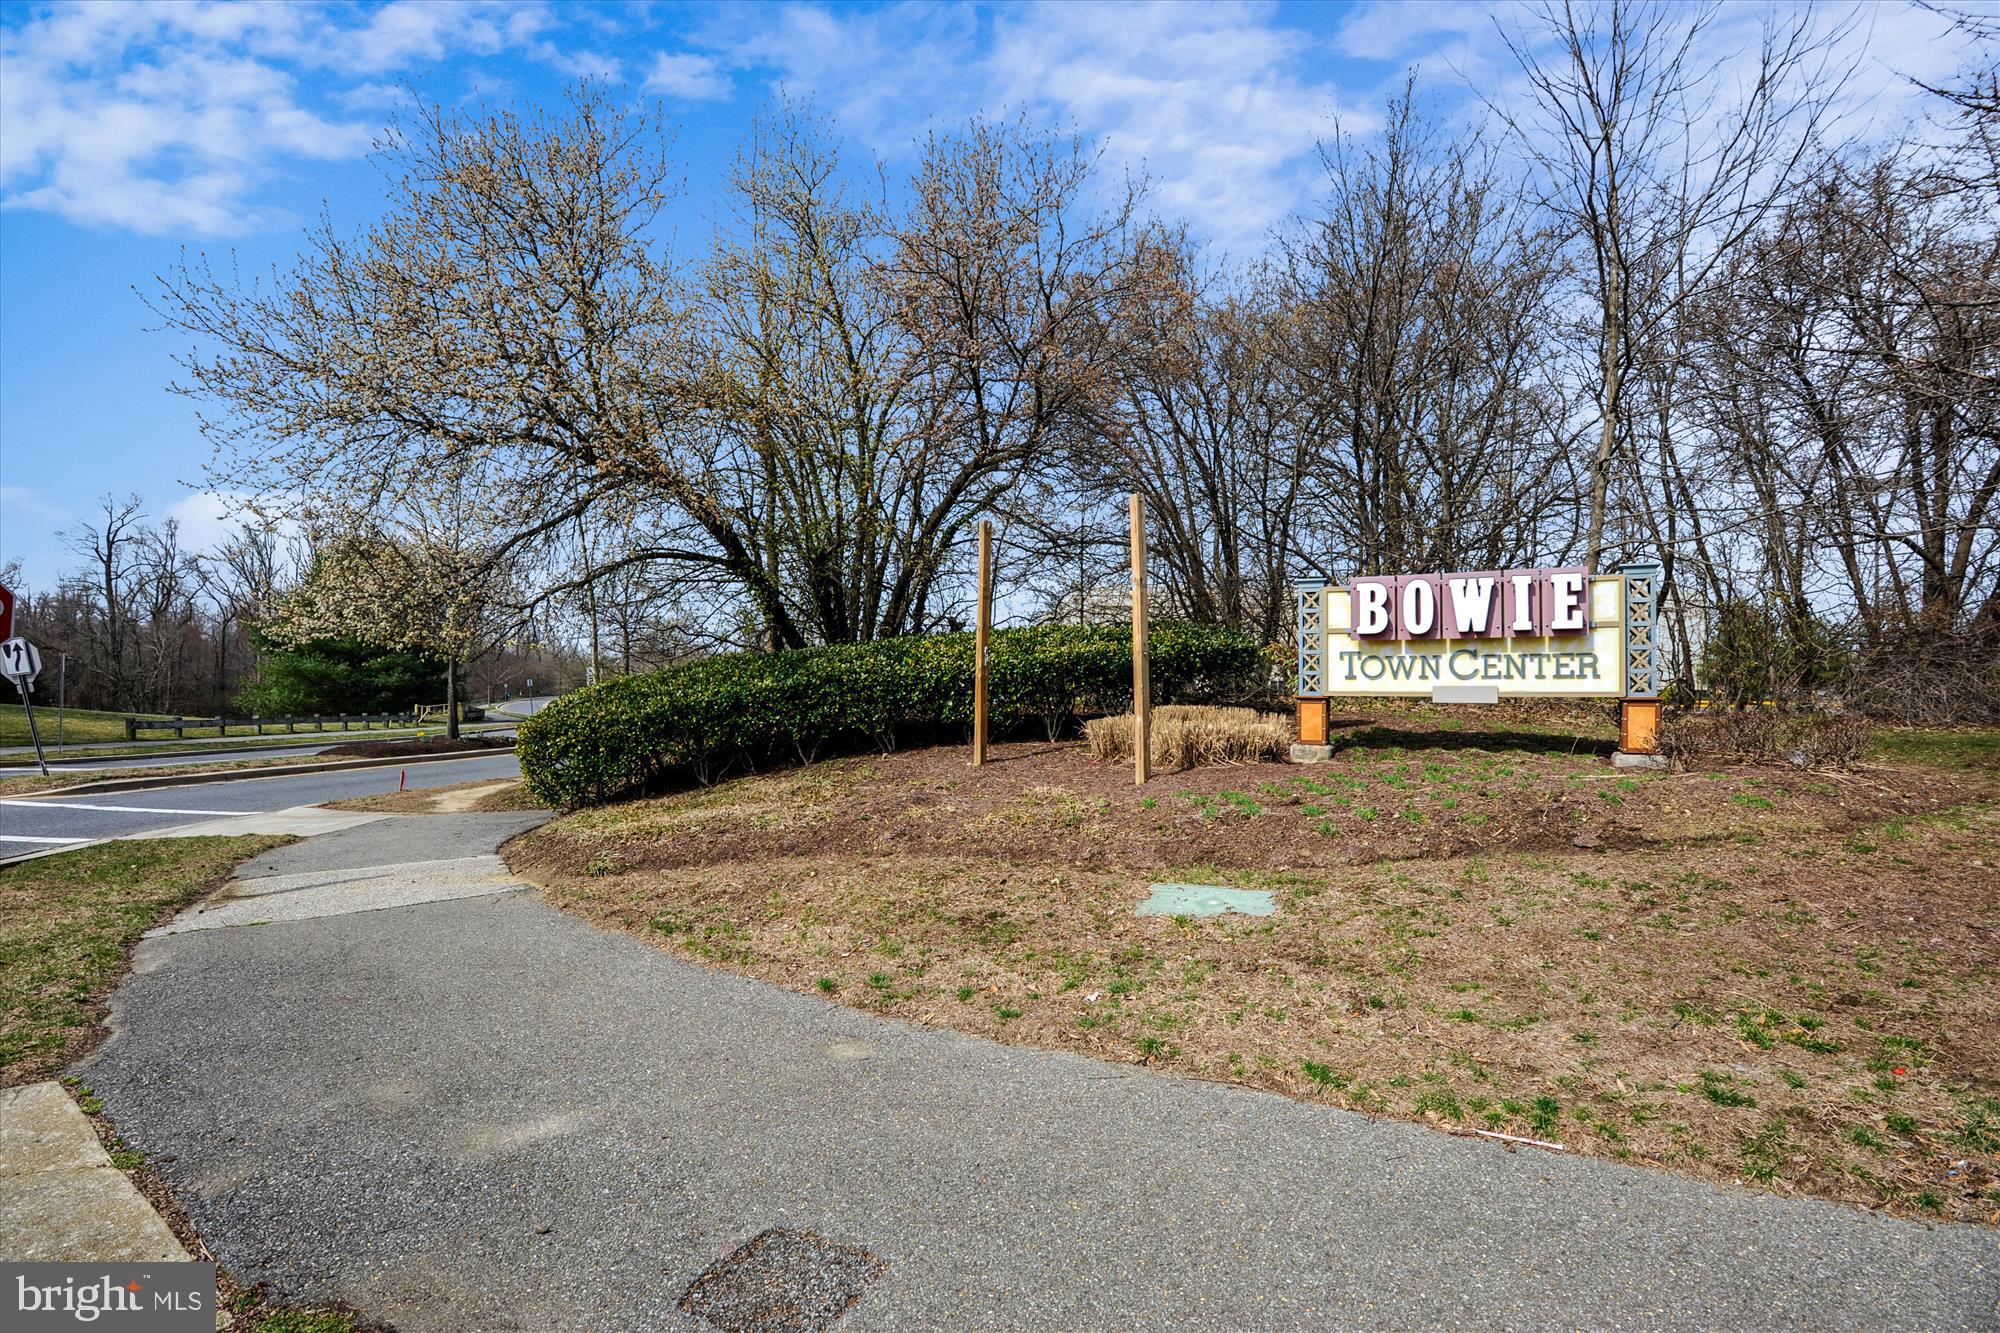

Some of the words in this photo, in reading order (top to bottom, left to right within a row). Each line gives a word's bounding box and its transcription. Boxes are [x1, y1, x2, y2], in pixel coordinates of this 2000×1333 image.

[1355, 572, 1584, 635] BOWIE
[1339, 651, 1442, 680] TOWN
[1449, 649, 1600, 680] CENTER
